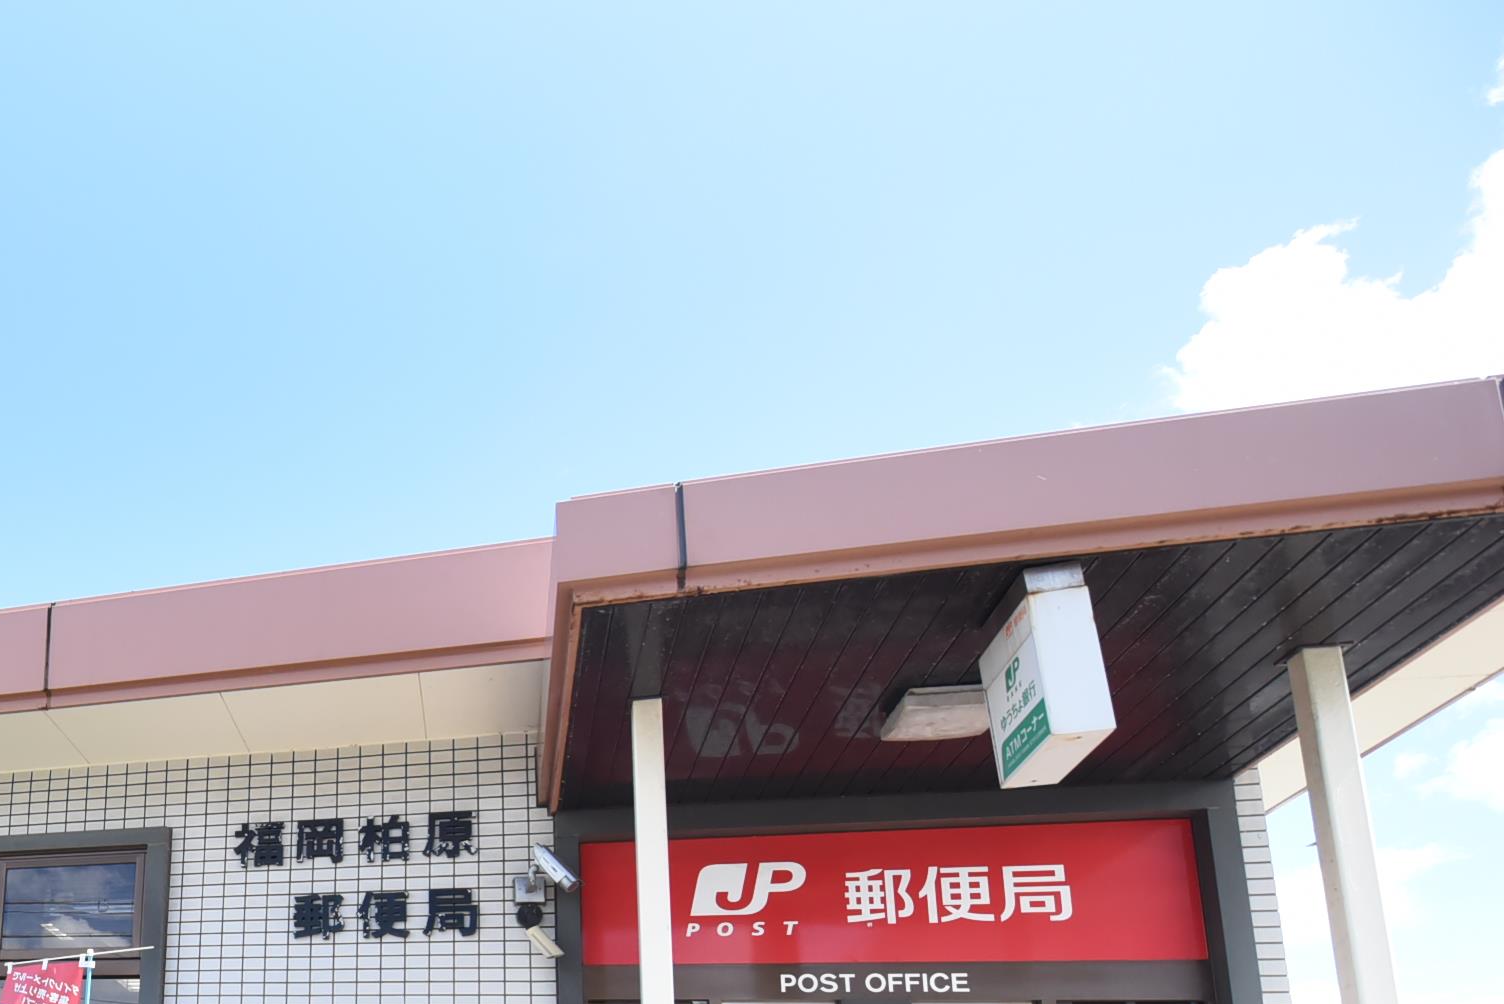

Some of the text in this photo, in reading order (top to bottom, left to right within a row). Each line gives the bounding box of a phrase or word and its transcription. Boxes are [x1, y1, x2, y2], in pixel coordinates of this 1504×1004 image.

[1000, 679, 1037, 732] ゆうちょ銀行
[1004, 711, 1044, 761] ATMコーナー
[234, 811, 479, 868] 福岡柏原
[293, 888, 479, 939] 郵便局
[690, 861, 806, 917] JP
[844, 863, 1073, 925] 郵便局
[685, 920, 800, 938] POST
[780, 971, 970, 994] POST OFFICE
